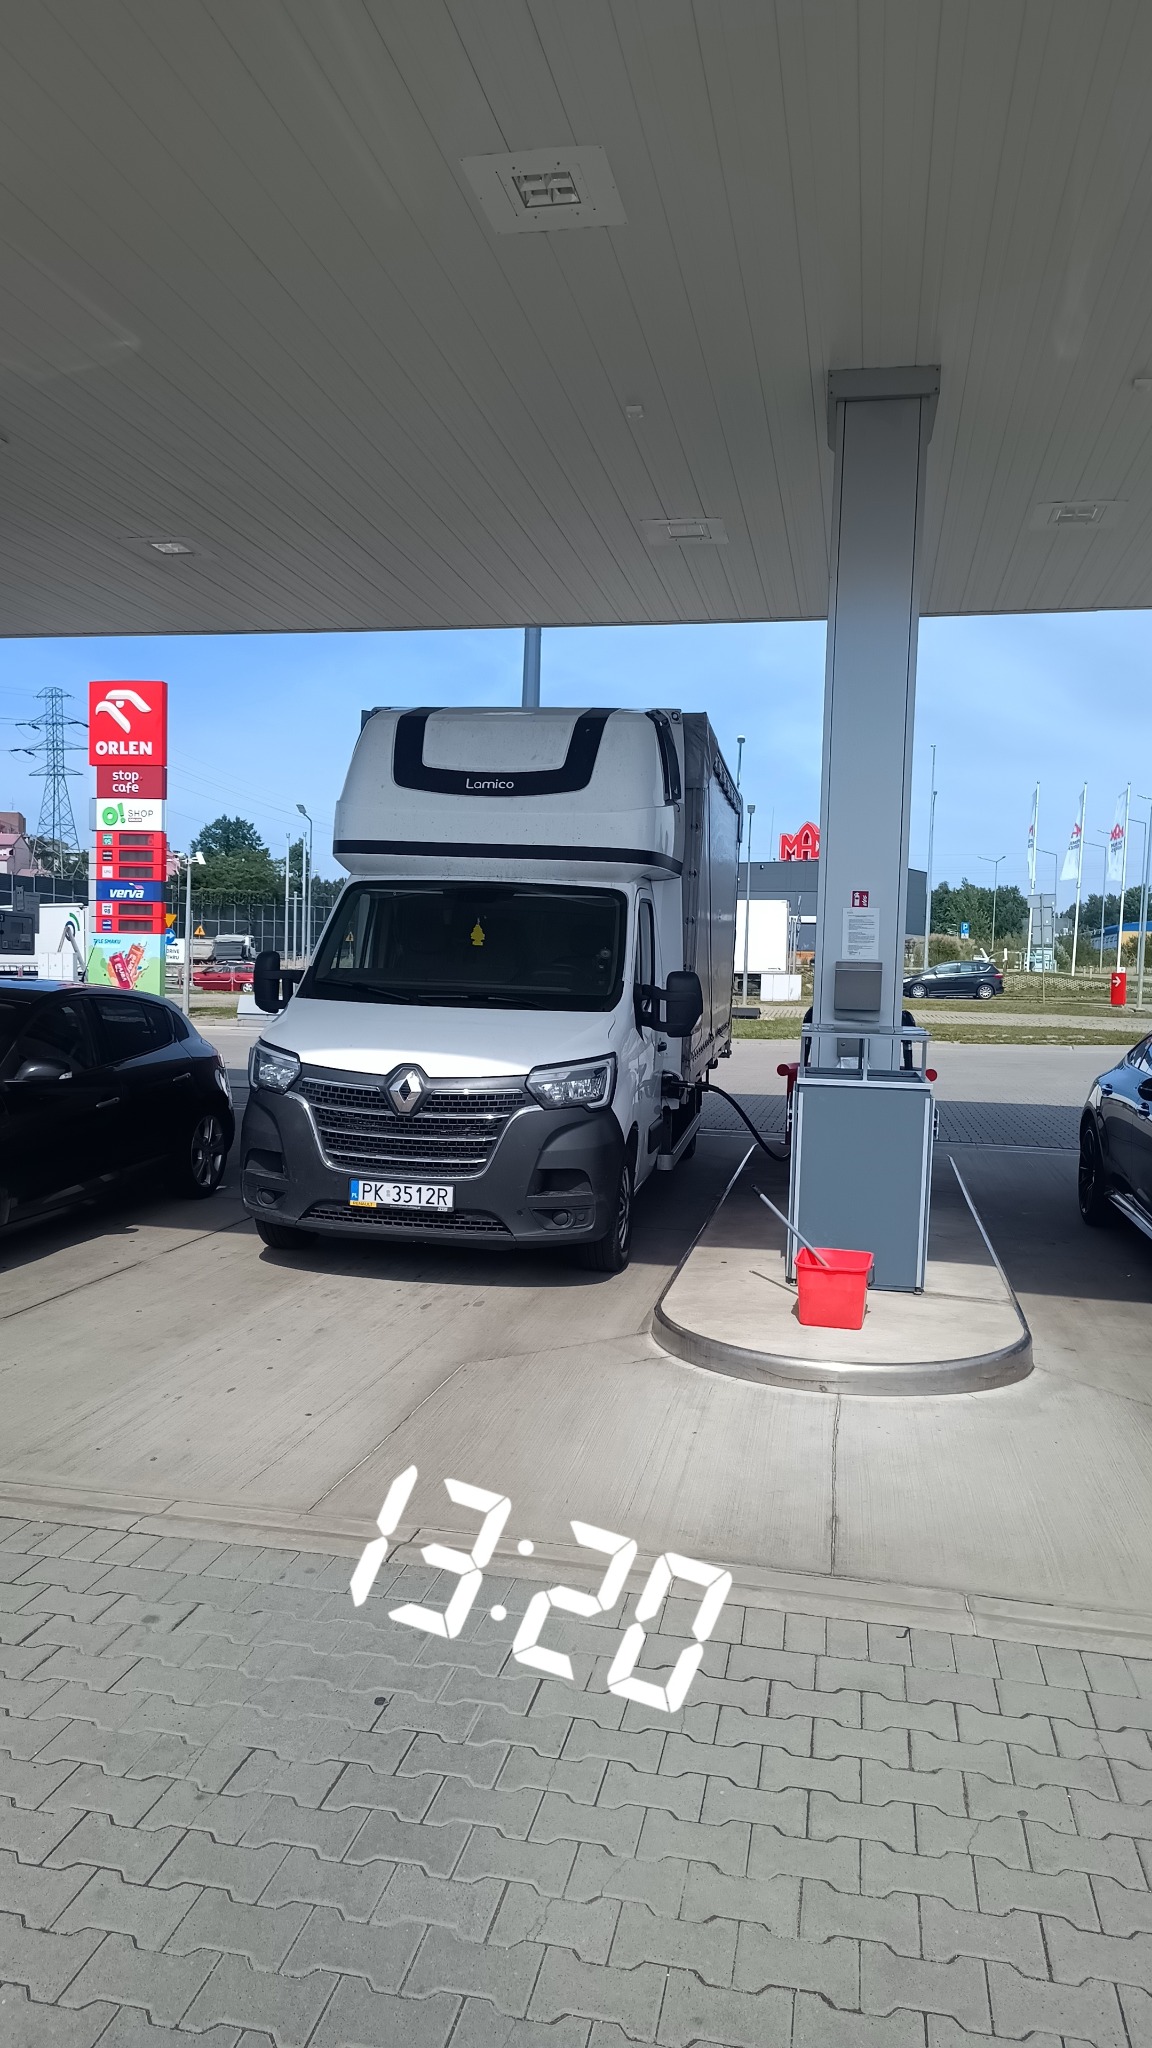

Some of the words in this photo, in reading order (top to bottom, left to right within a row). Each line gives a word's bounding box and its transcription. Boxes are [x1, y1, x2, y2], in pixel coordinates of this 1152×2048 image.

[95, 740, 153, 756] ORLEN
[112, 782, 139, 794] cafe
[465, 777, 515, 789] Lamico
[127, 809, 154, 818] SHOP
[109, 888, 144, 899] verva
[362, 1183, 384, 1202] PK
[391, 1185, 448, 1206] 3512R
